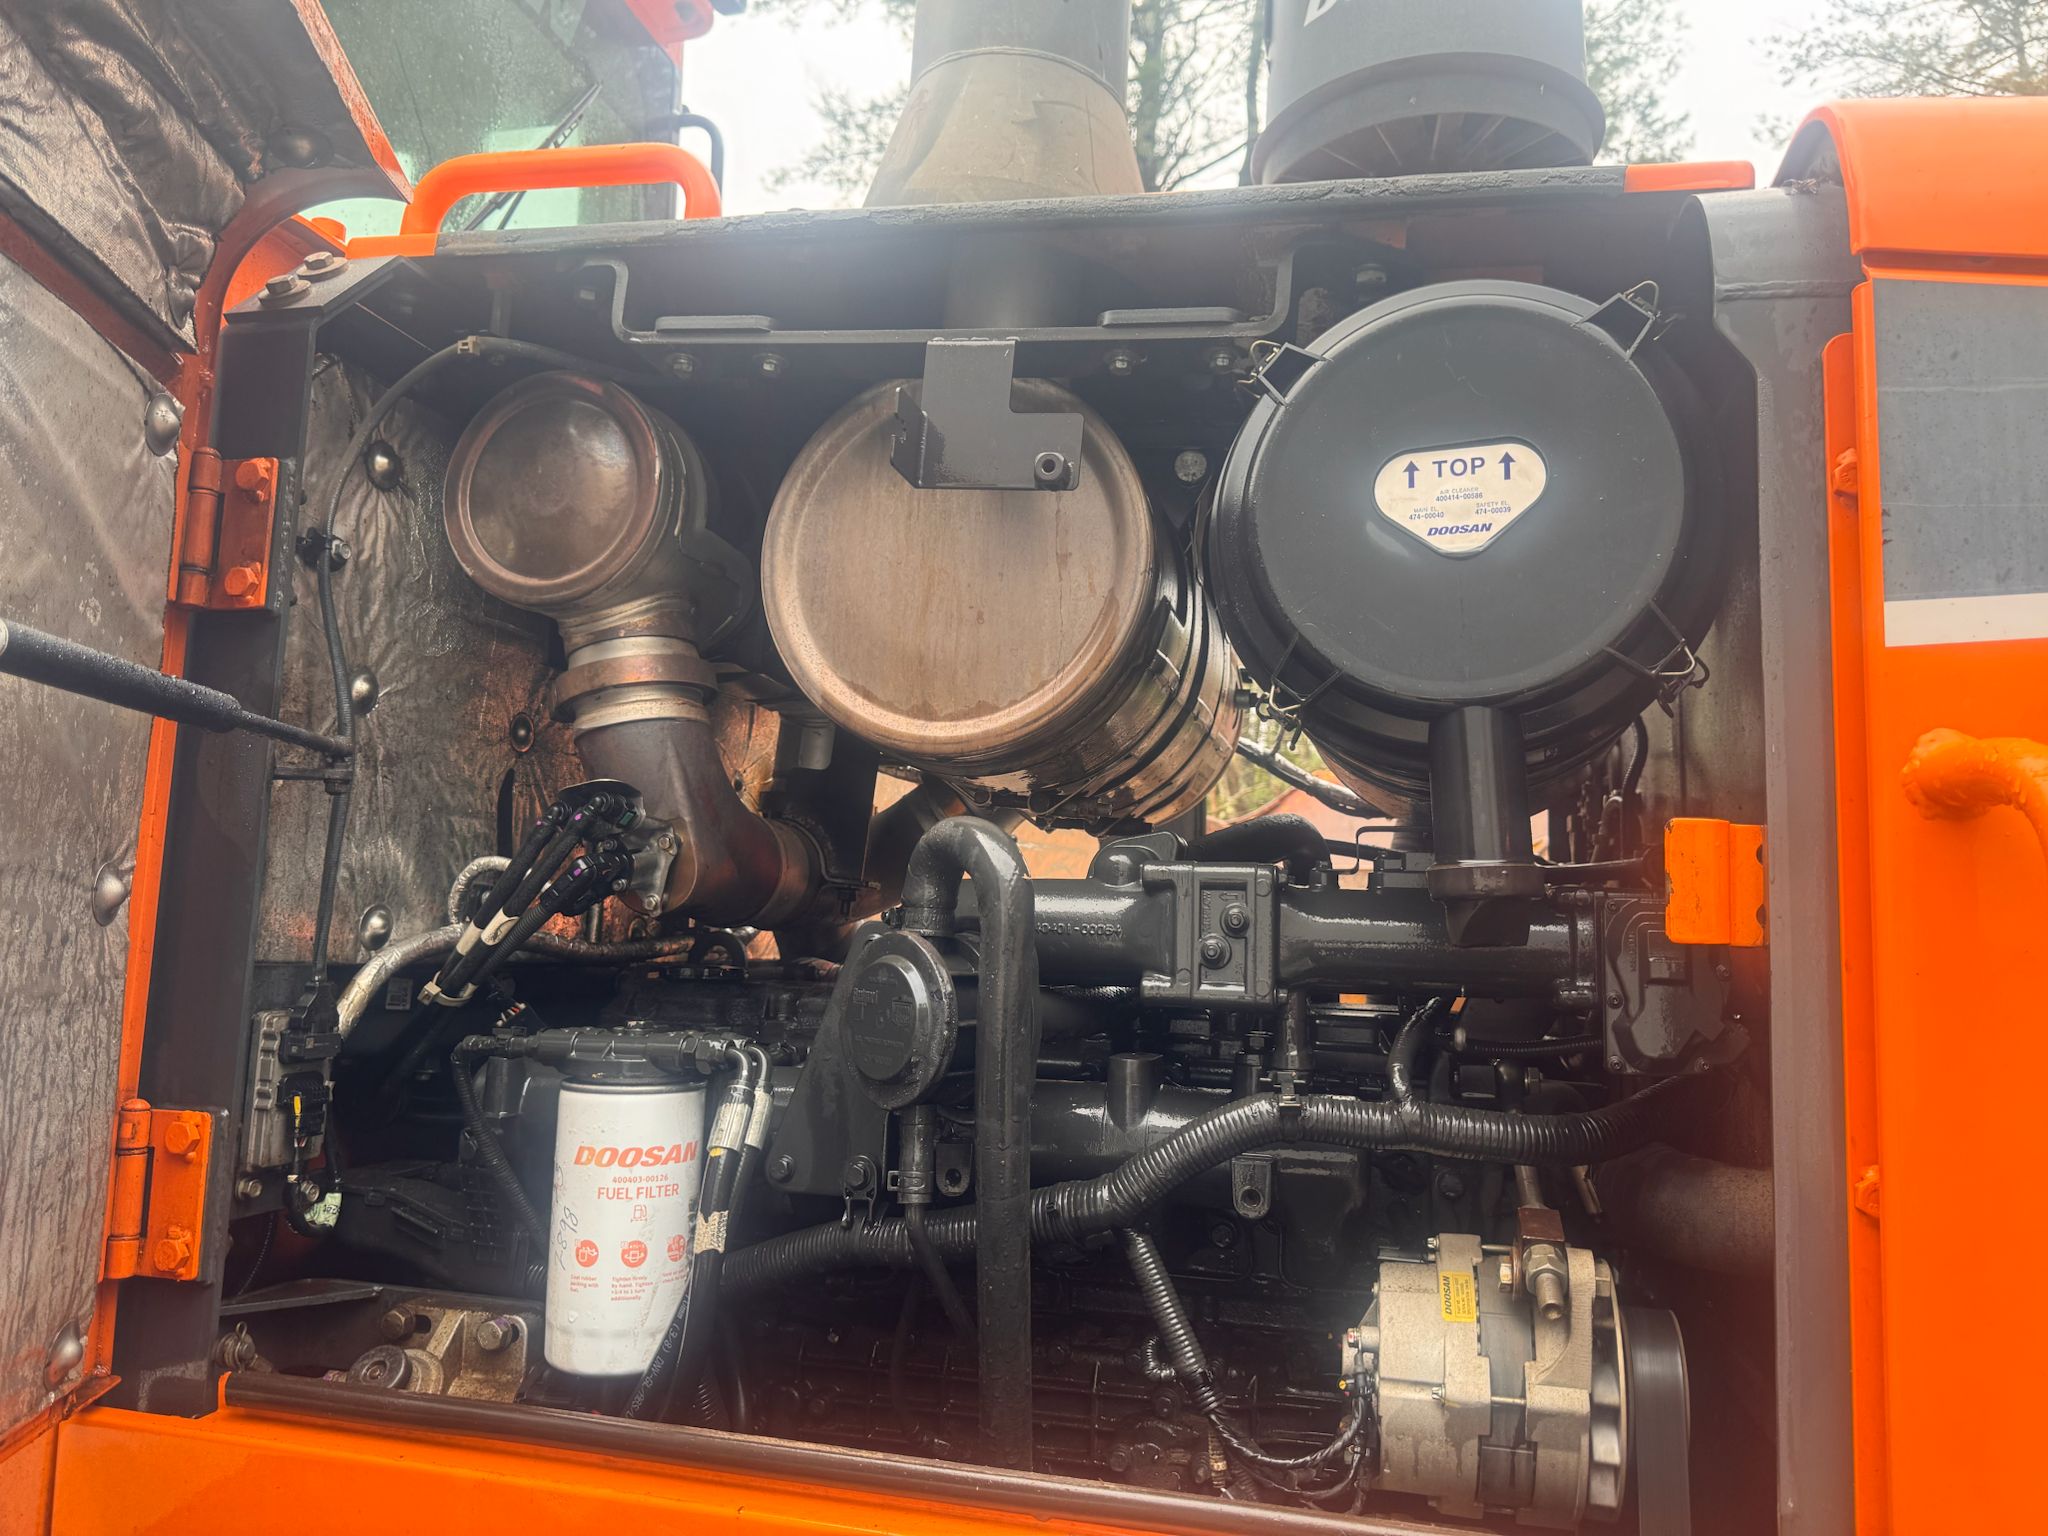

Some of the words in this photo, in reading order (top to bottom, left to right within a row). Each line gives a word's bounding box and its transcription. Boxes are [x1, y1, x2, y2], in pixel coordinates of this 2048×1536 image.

[1432, 457, 1485, 478] TOP
[1452, 486, 1479, 494] CLEANER
[1427, 522, 1493, 537] DOOSAN
[574, 1140, 699, 1168] DOOSAN
[597, 1186, 633, 1200] FUEL
[636, 1183, 680, 1200] FILTER
[1443, 1275, 1452, 1315] DOOSAN
